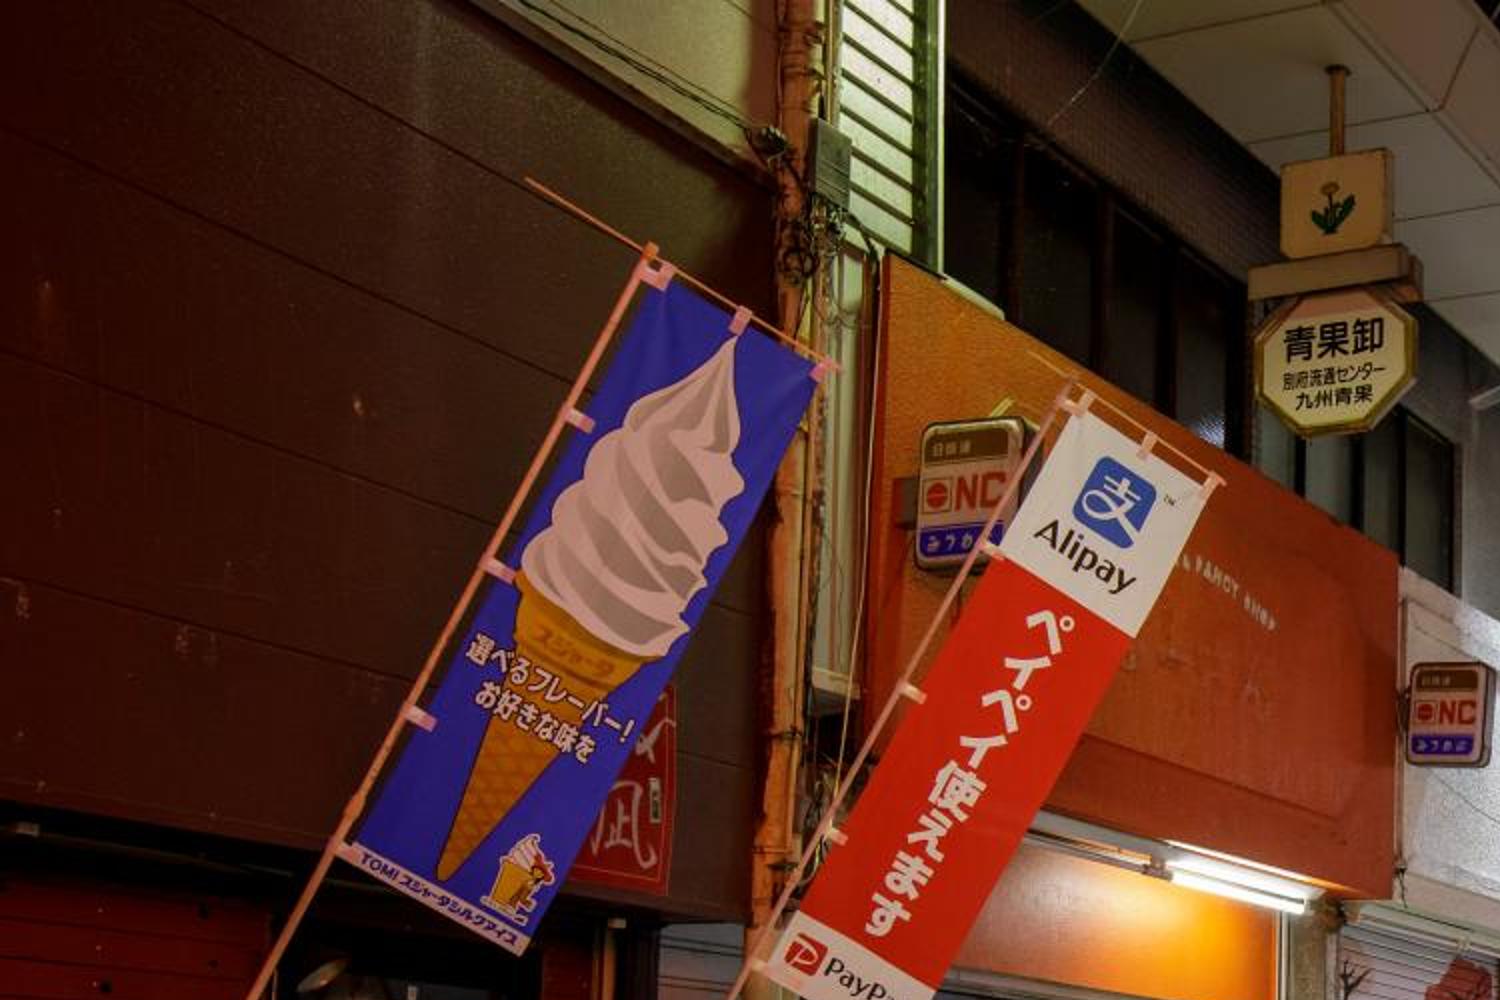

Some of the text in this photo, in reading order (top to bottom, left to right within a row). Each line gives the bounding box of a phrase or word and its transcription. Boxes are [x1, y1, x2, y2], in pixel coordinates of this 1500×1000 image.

[1283, 317, 1385, 363] 青果卸
[1295, 384, 1374, 411] 九州青果
[1033, 519, 1137, 595] Alipay
[465, 632, 636, 744] 選べるフレーバー!
[1438, 700, 1477, 726] NC
[475, 680, 597, 764] お好きな味を
[863, 609, 1076, 937] ペイペイ使えます
[359, 853, 398, 880] TOMI
